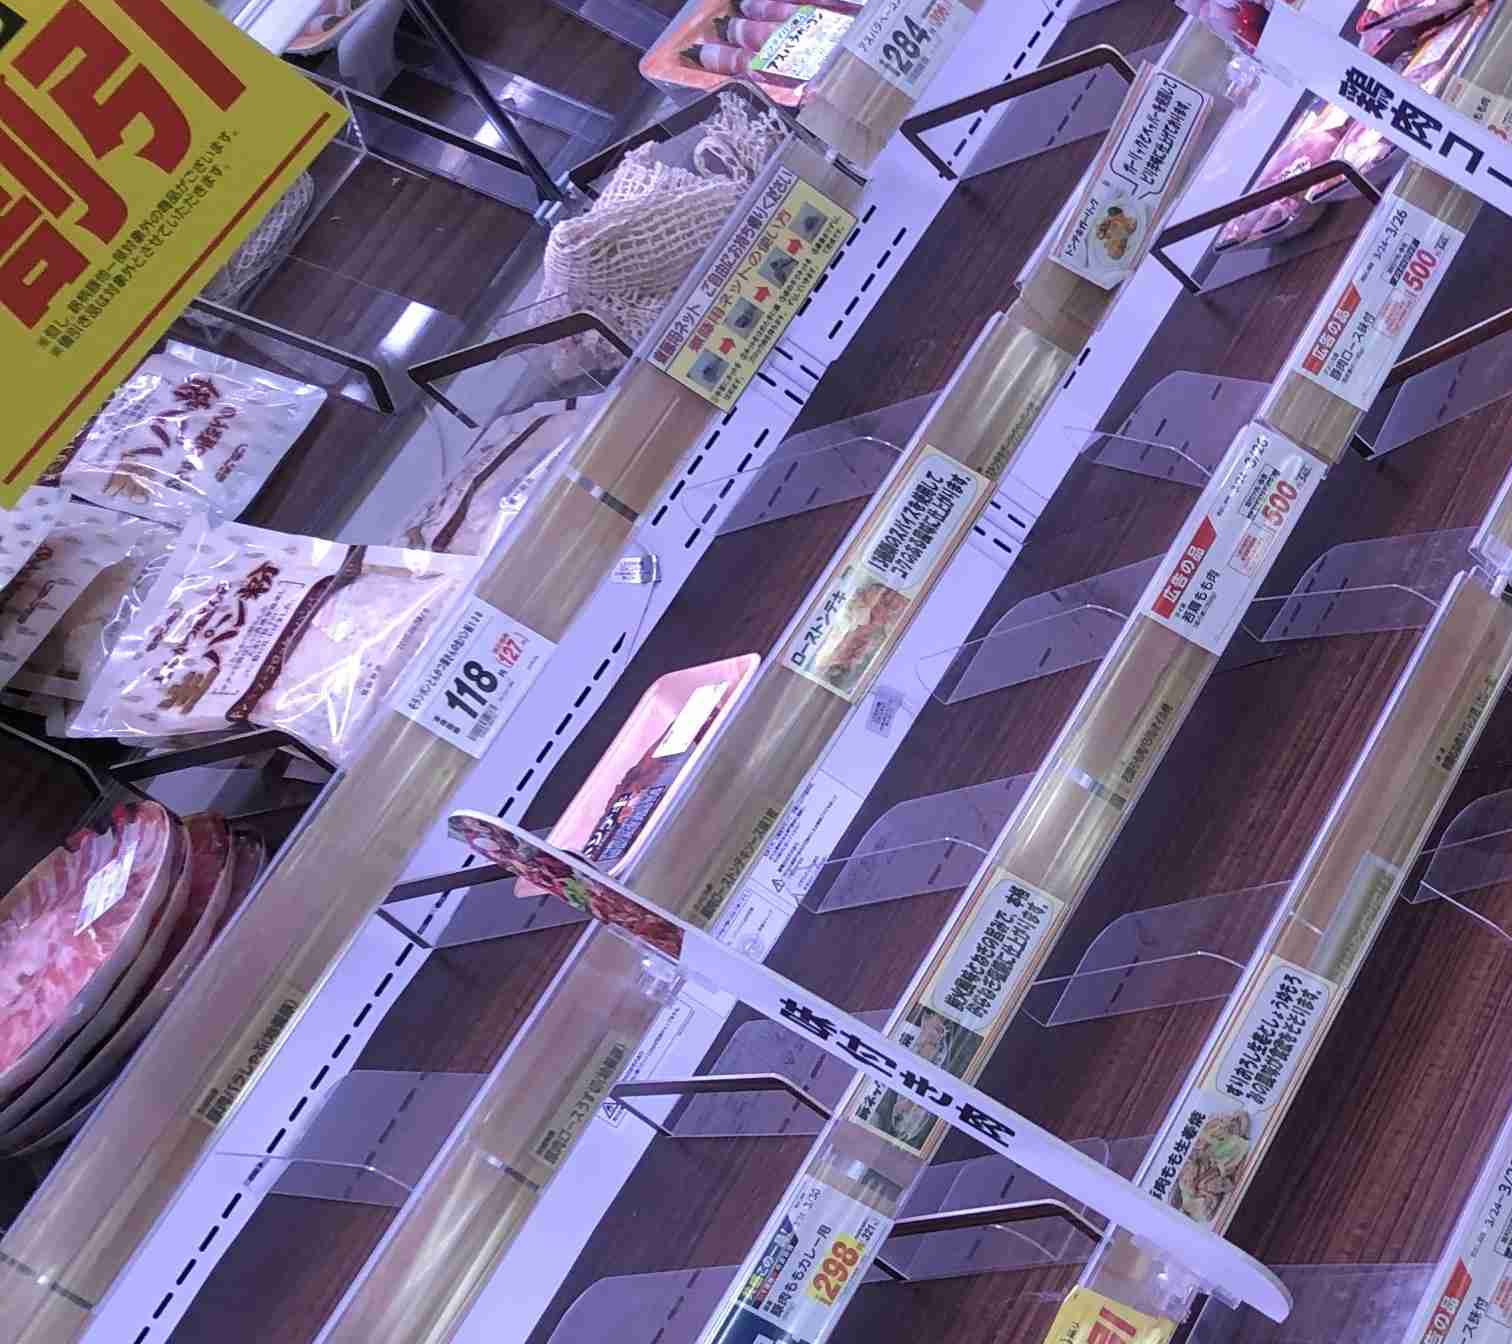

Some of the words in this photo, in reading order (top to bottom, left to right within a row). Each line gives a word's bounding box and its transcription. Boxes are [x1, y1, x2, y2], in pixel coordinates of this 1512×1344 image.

[878, 13, 935, 75] 284
[1400, 246, 1440, 293] 500
[1310, 305, 1351, 361] 広告の品
[1328, 311, 1376, 382] 豚肉ロース味付
[1258, 478, 1300, 528] 500
[1162, 542, 1205, 603] 広告の品
[1181, 567, 1221, 625] 若鶏もも肉
[439, 655, 503, 723] 118
[780, 996, 1018, 1148] 味付き肉
[1148, 1107, 1207, 1200] 肉もも生姜焼
[769, 1222, 832, 1318] 豚肉ももカレー用
[808, 1237, 862, 1302] 298
